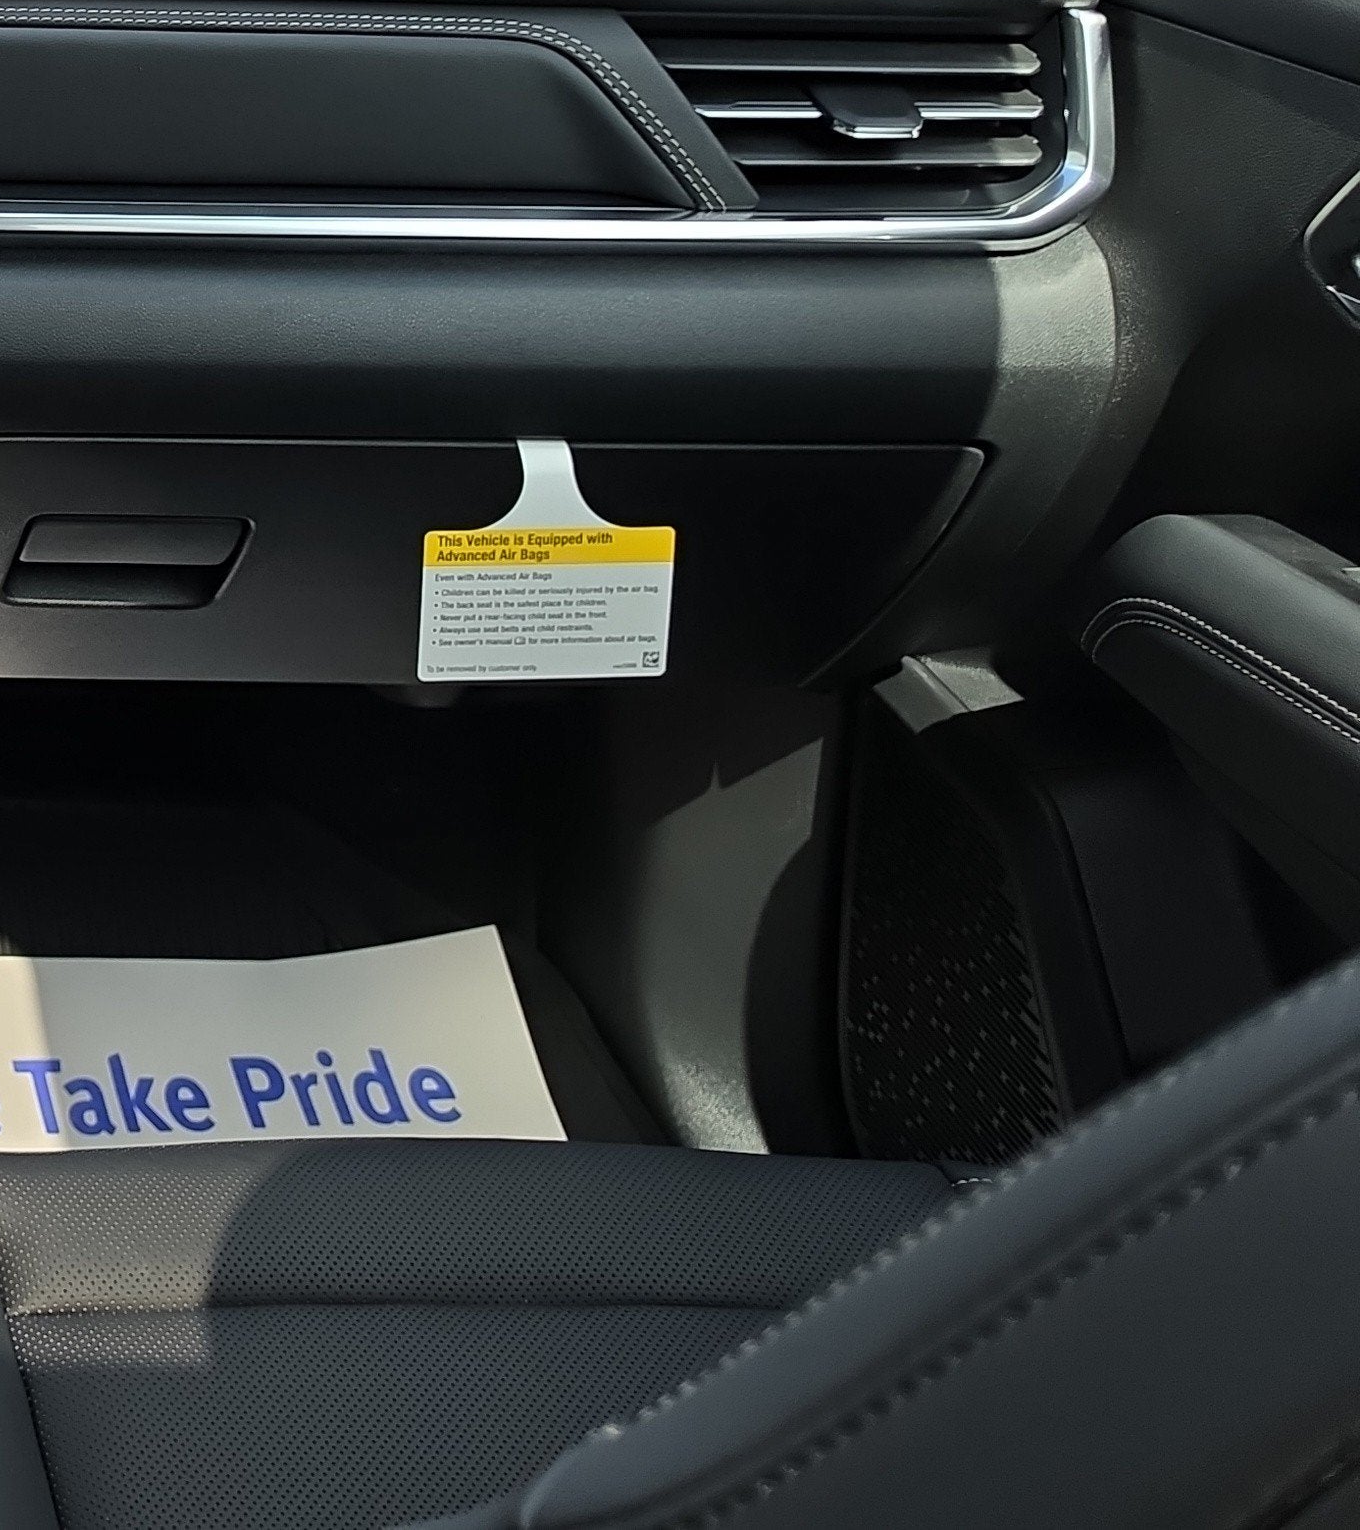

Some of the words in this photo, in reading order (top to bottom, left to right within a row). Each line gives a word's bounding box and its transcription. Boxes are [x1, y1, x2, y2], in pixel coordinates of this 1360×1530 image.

[437, 534, 463, 547] This
[466, 534, 510, 547] Vehicle
[513, 534, 524, 546] is
[527, 532, 583, 548] Equipped
[586, 532, 613, 544] with
[436, 549, 496, 562] Advanced
[500, 548, 517, 560] Air
[520, 548, 550, 563] Bags
[435, 573, 455, 582] Even
[457, 573, 475, 581] with
[477, 573, 517, 581] Advanced
[519, 572, 530, 580] Air
[532, 572, 552, 581] Bags
[11, 1054, 217, 1137] Take
[229, 1047, 463, 1131] Pride
